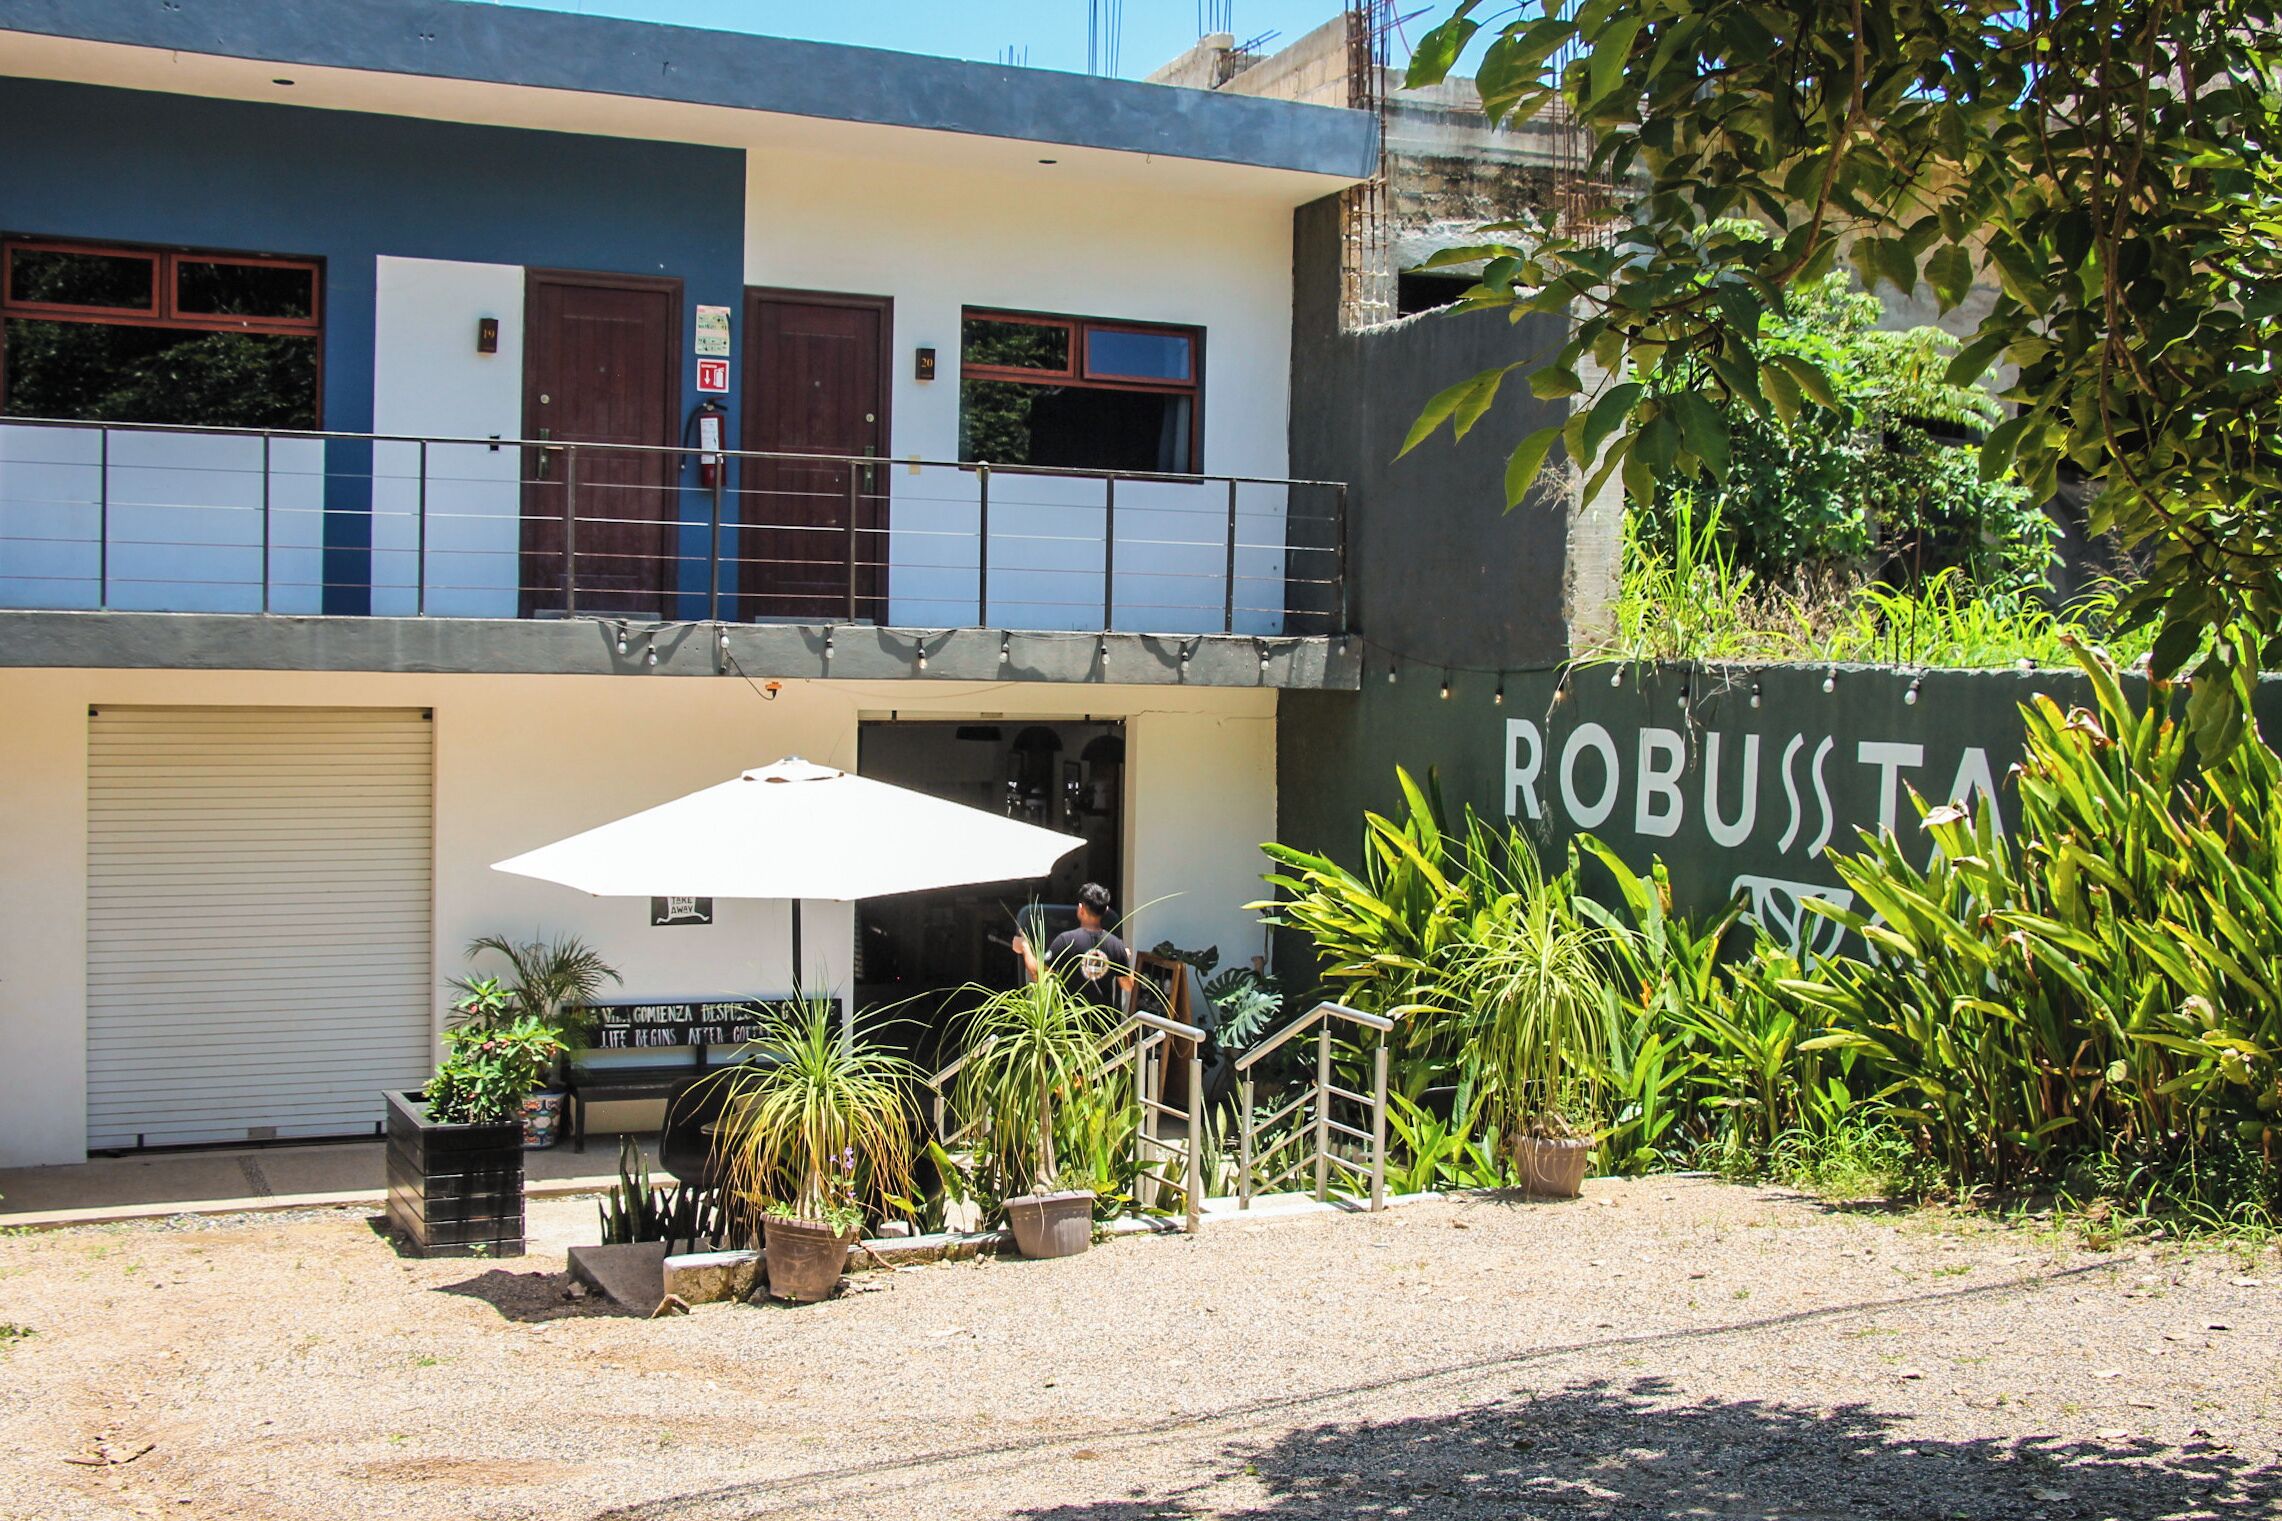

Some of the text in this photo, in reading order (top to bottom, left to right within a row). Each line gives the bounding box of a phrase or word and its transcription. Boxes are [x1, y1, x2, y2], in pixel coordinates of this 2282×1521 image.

[921, 357, 933, 368] 20
[671, 896, 693, 904] TAKE
[671, 905, 693, 914] AWAY
[633, 1004, 694, 1024] COMIENZA
[600, 1029, 628, 1049] LIFE
[635, 1028, 677, 1048] BEGINS
[688, 1026, 724, 1045] AFTER
